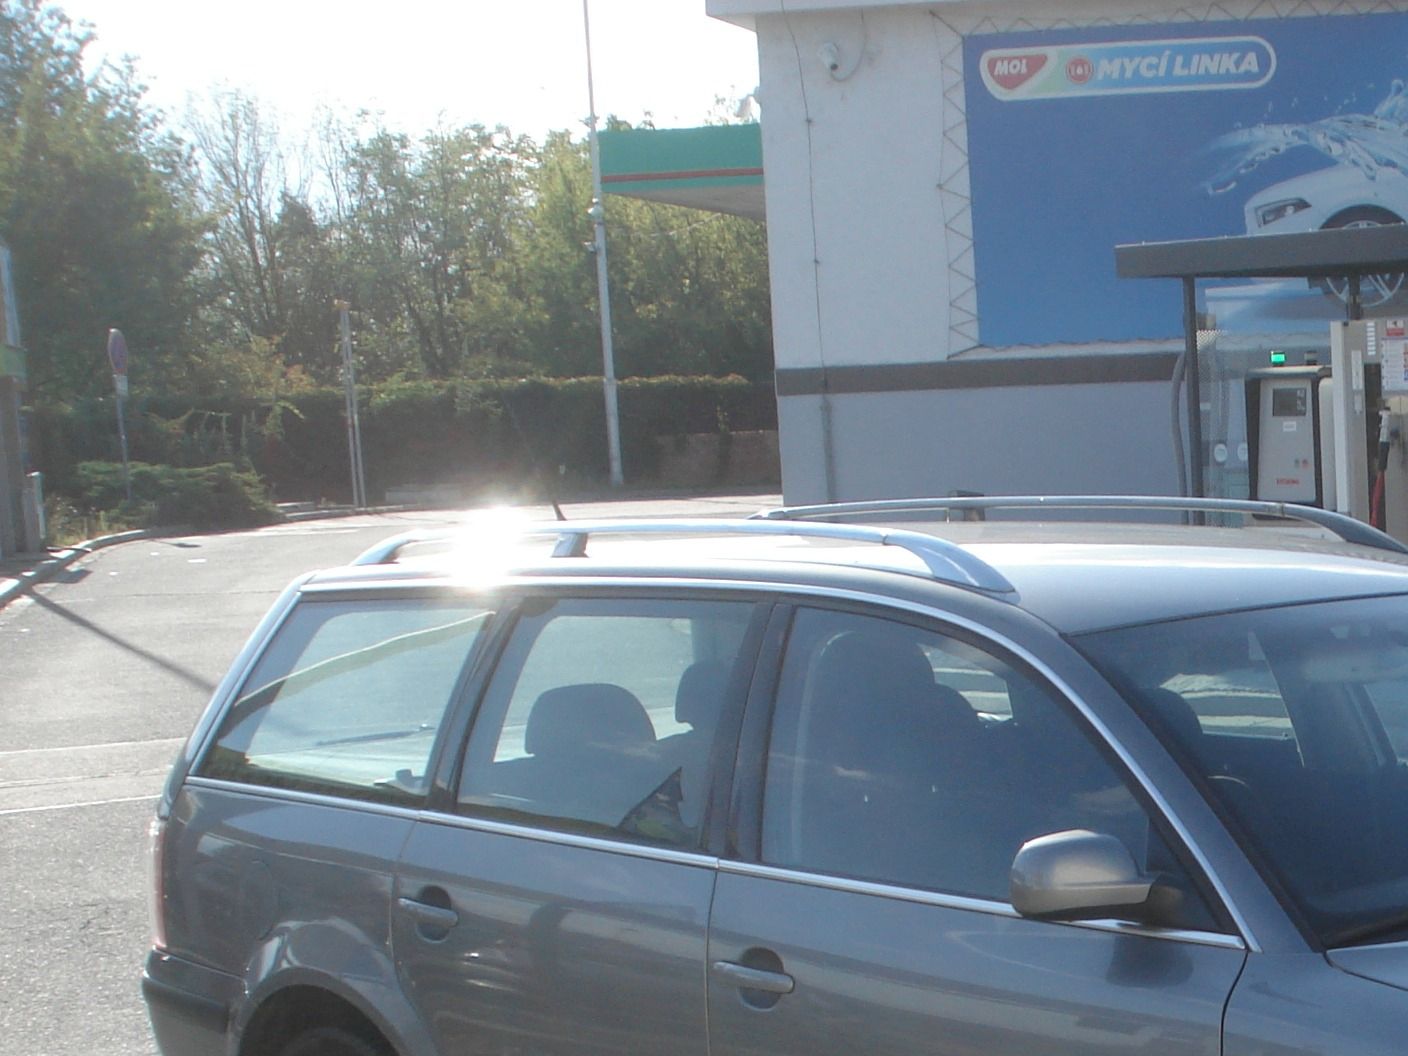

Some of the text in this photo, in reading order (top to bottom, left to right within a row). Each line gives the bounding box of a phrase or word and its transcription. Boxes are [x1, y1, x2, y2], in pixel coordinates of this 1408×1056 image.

[993, 59, 1027, 76] MOL
[1097, 51, 1260, 81] MYCÍ LINKA
